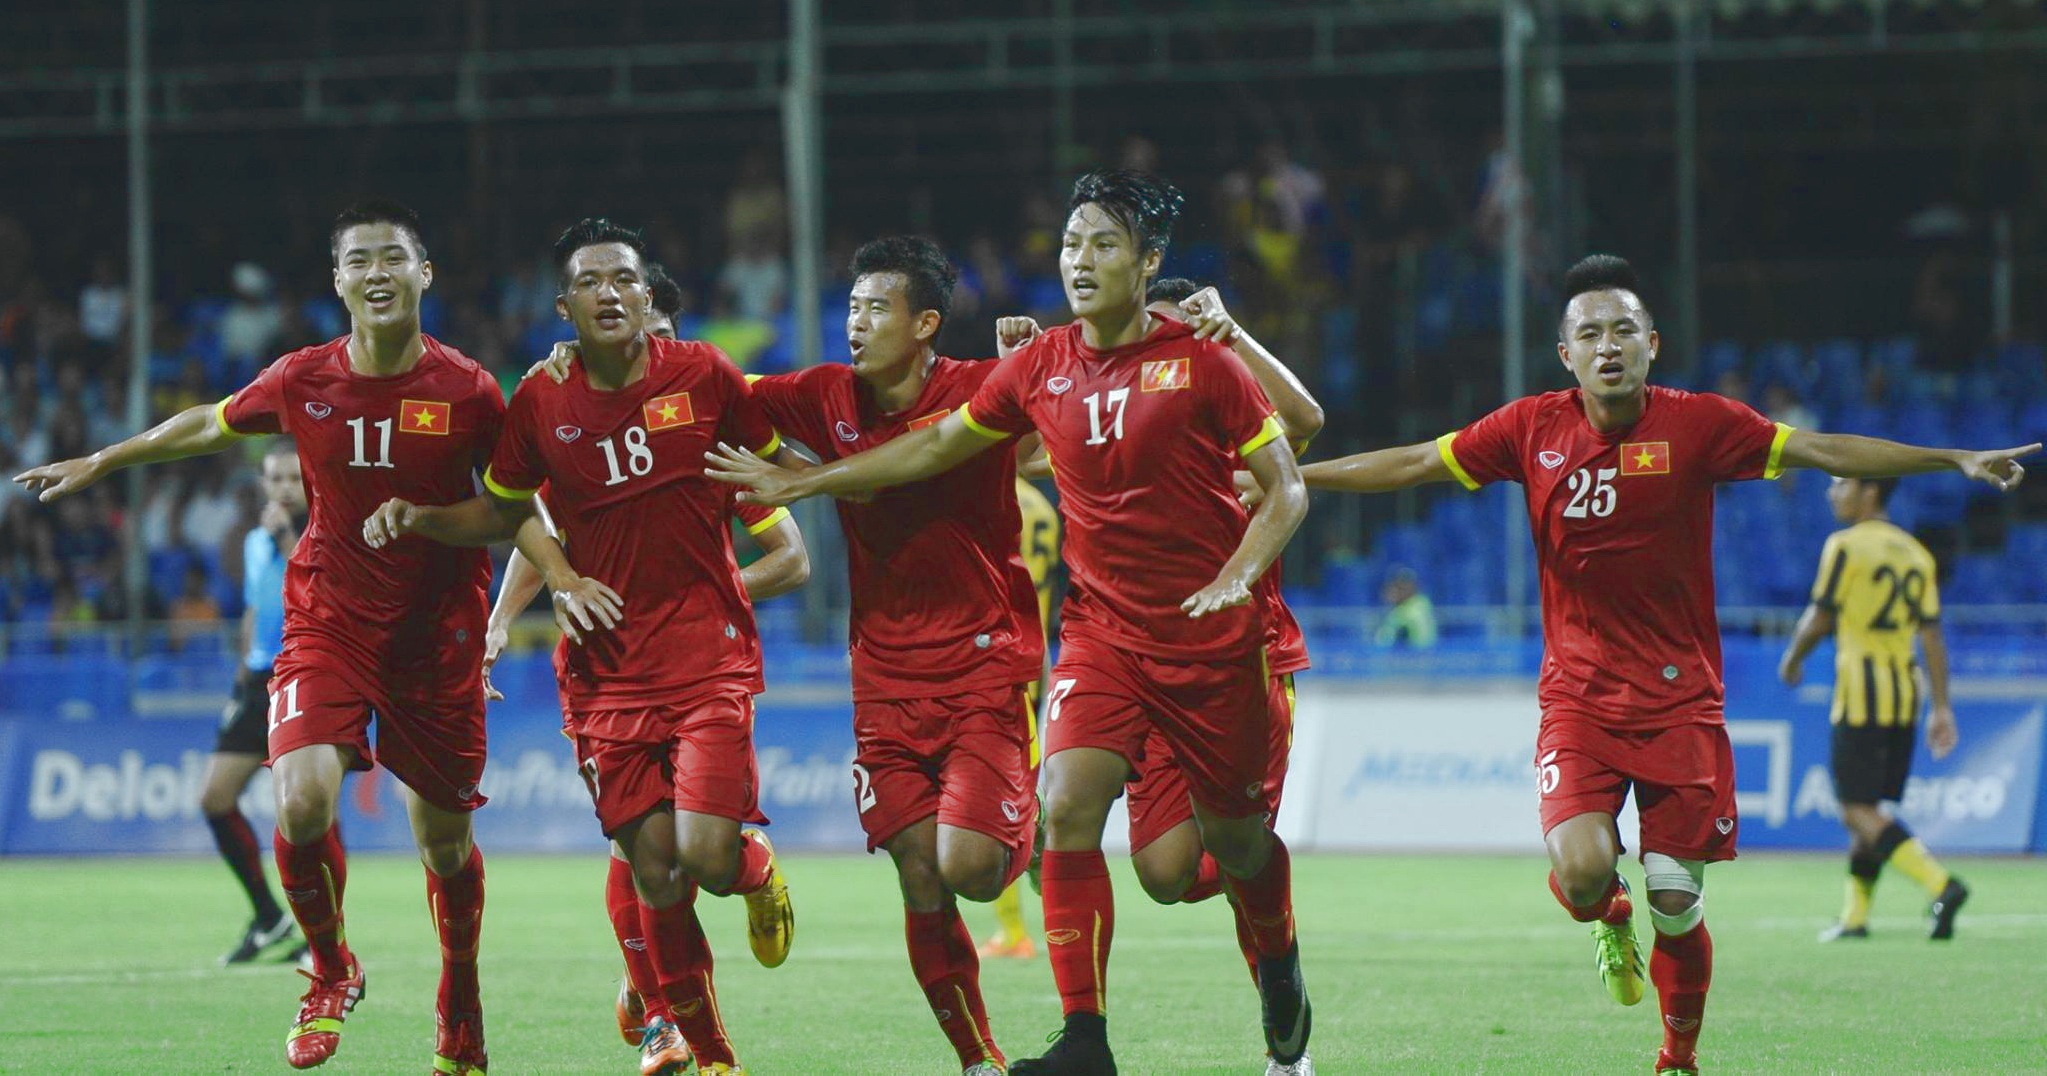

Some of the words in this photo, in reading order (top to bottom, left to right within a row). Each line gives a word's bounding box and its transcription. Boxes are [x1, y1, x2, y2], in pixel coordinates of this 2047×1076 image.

[346, 416, 395, 468] 11
[1083, 386, 1131, 446] 17
[595, 425, 654, 486] 18
[1563, 467, 1618, 518] 25
[1868, 563, 1926, 631] 29
[268, 678, 303, 736] 11
[1047, 678, 1077, 721] 7
[1536, 750, 1560, 794] 5
